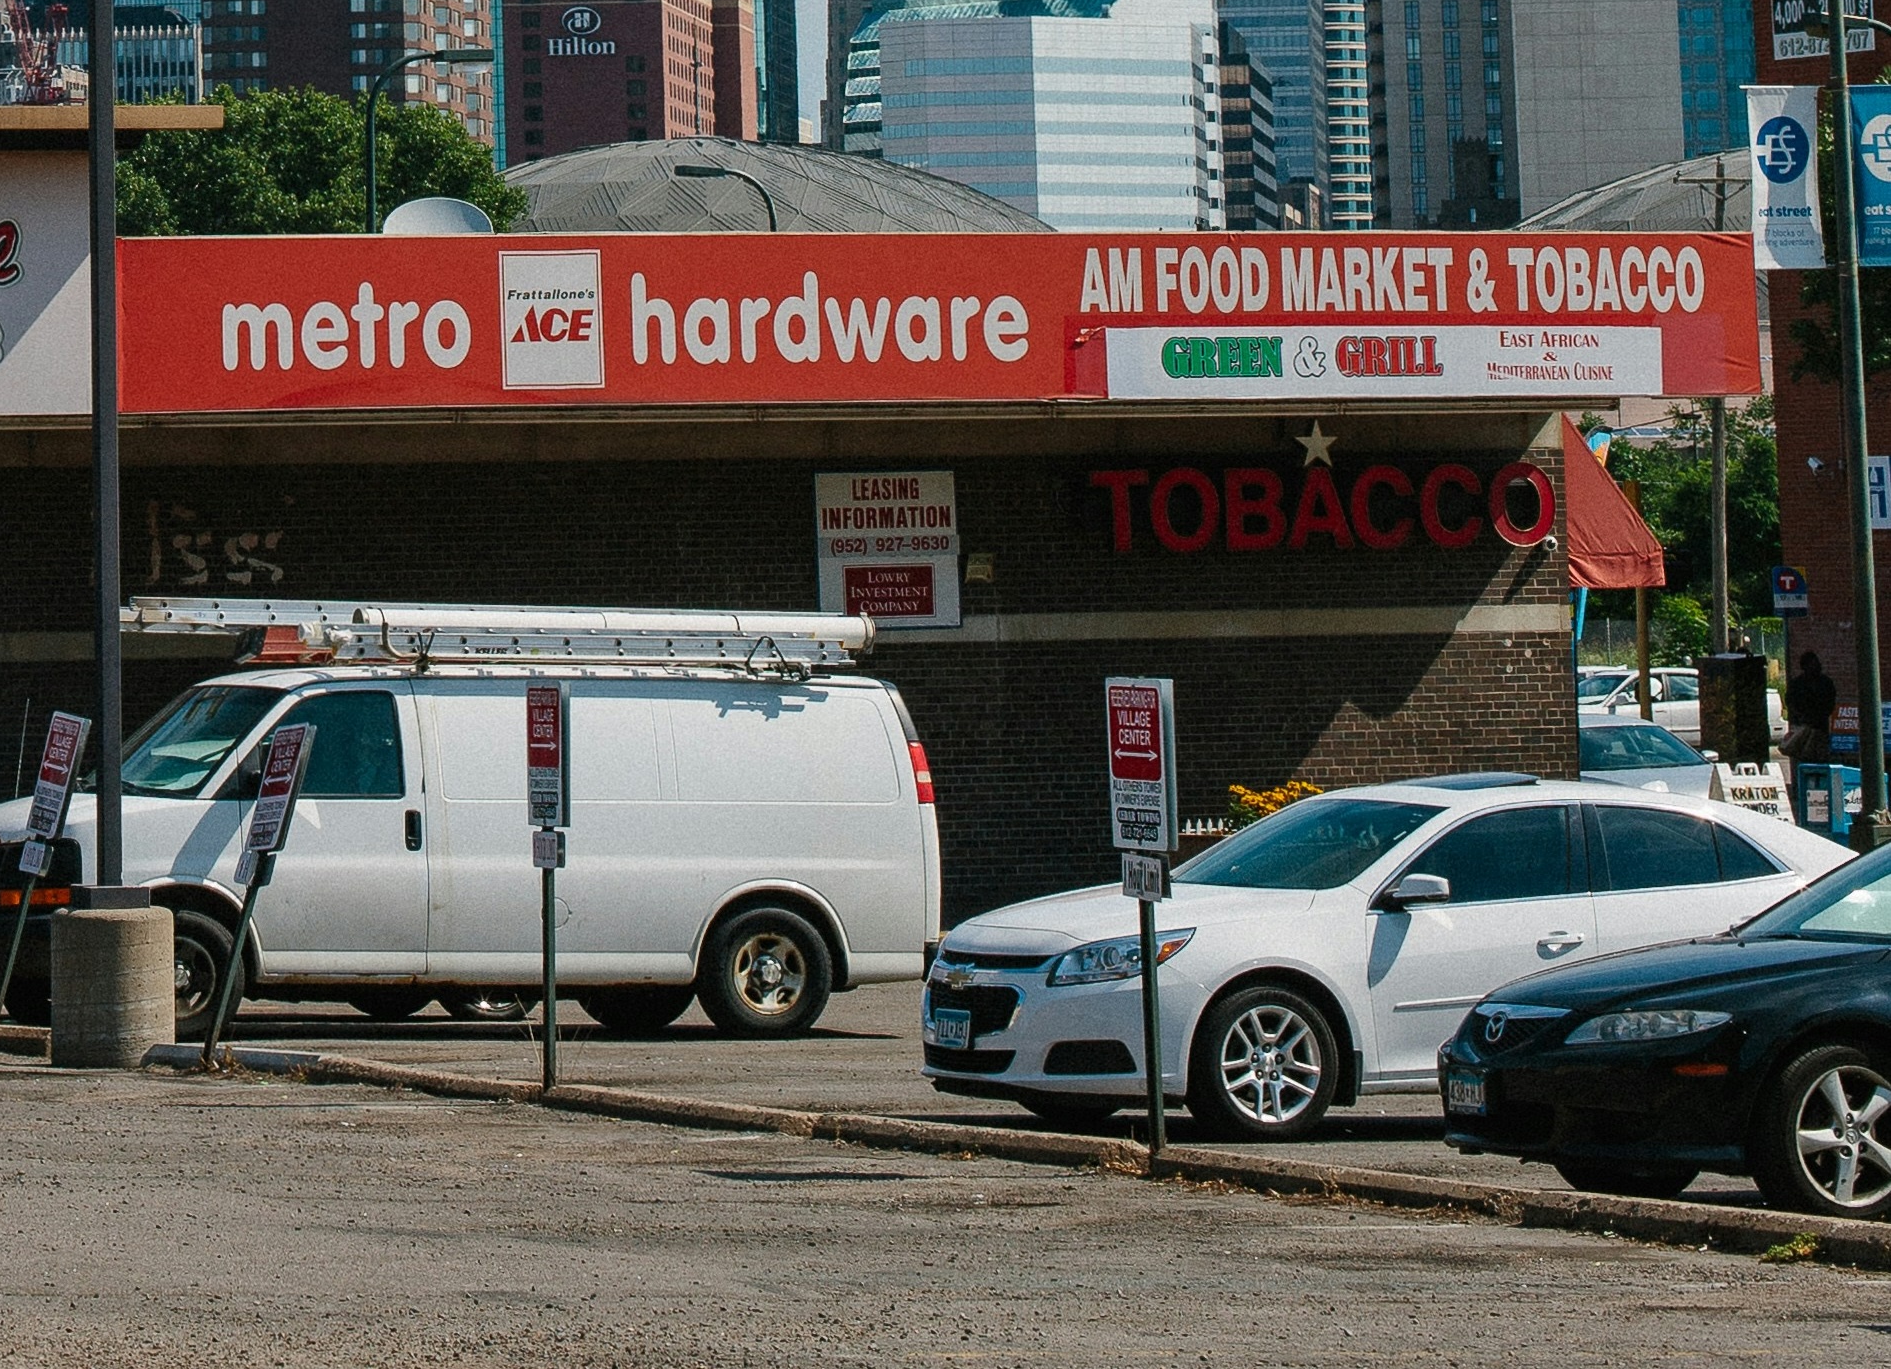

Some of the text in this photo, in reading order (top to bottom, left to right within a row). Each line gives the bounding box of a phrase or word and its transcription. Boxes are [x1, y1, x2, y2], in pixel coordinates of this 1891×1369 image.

[548, 36, 616, 56] Hilton
[1776, 205, 1813, 217] street
[1864, 203, 1884, 216] eat
[1080, 245, 1706, 314] AM FOOD MARKET & TOBACCO
[508, 288, 595, 300] Frattallone's
[222, 281, 472, 371] metro
[510, 304, 594, 343] ACE
[630, 271, 1030, 365] hardware
[1161, 335, 1444, 378] GREEN & GRILL
[1542, 351, 1558, 362] &
[851, 477, 920, 502] LEASING
[1089, 462, 1556, 552] TOBACCO
[821, 505, 952, 530] INFORMATION
[830, 538, 868, 557] (952)
[1117, 710, 1151, 727] VILLAGE
[1118, 728, 1151, 746] CENTER
[1730, 787, 1779, 801] KRATOM
